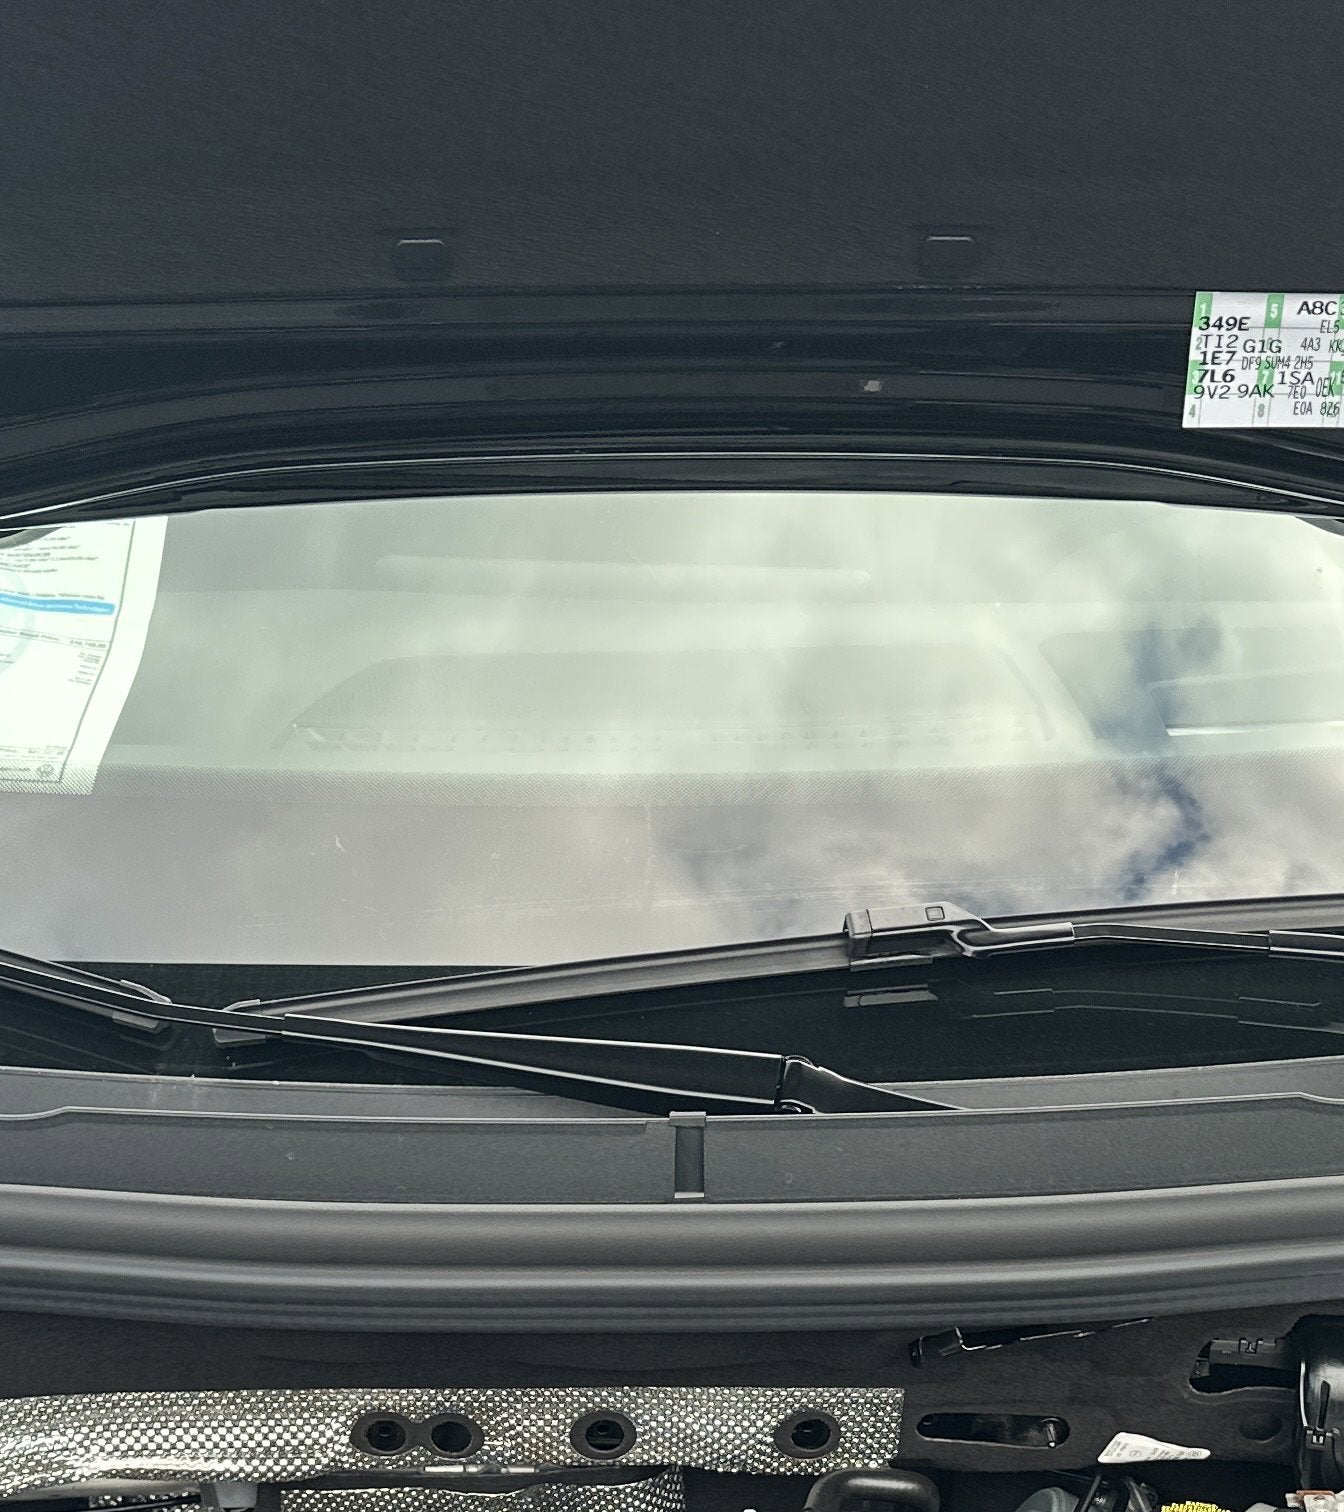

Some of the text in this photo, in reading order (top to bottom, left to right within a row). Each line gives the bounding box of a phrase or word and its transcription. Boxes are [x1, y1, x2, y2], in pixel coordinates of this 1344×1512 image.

[1199, 316, 1251, 331] 349E
[1199, 350, 1237, 366] 1E7
[1198, 368, 1236, 384] 7L6
[1278, 370, 1315, 385] 1SA
[1194, 384, 1231, 399] 9V2
[1237, 383, 1275, 398] 9AK
